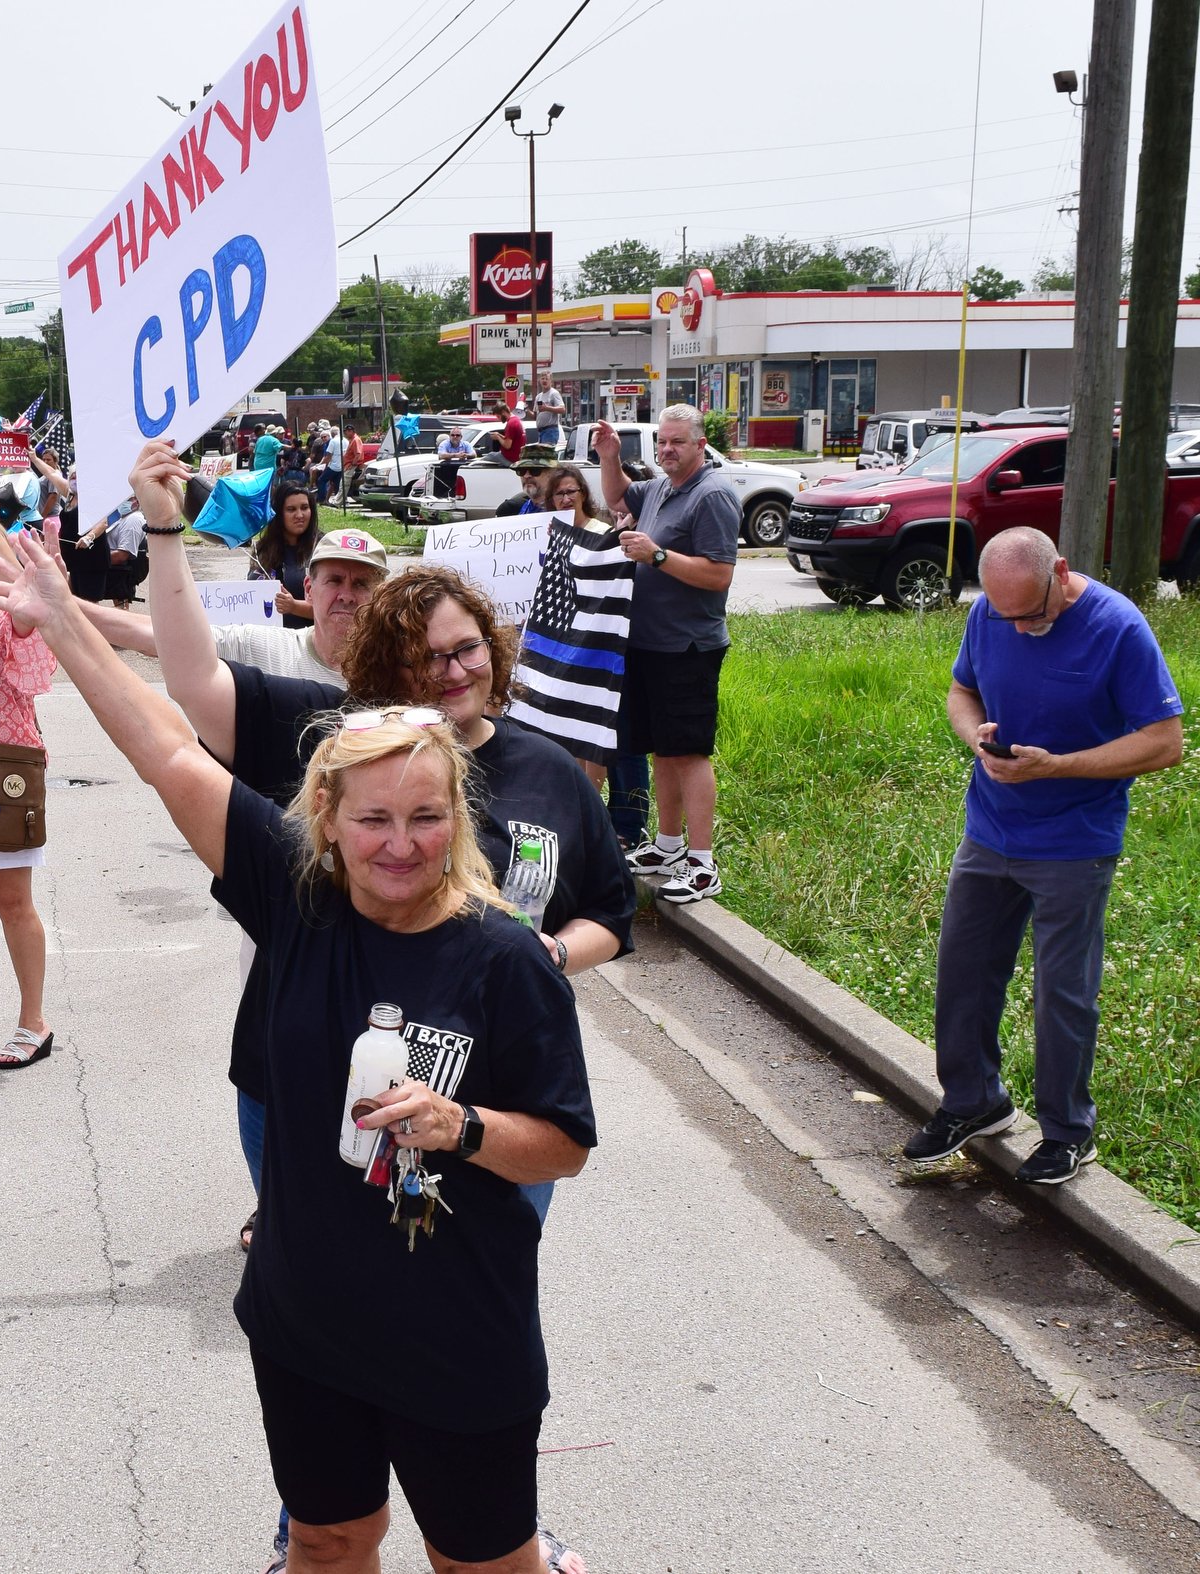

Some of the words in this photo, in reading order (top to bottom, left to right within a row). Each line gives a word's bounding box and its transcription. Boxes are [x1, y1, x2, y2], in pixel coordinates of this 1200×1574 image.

[67, 105, 225, 314] THANK
[213, 5, 308, 174] YOU
[133, 234, 267, 439] CPD
[481, 328, 509, 338] DRIVE
[504, 339, 527, 348] ONLY
[672, 341, 701, 355] BURGERS
[767, 380, 784, 390] BBQ
[433, 528, 460, 550] WE
[492, 558, 533, 578] LAW
[511, 822, 516, 832] I
[520, 824, 556, 843] BACK
[406, 1025, 414, 1039] I
[417, 1028, 470, 1055] BACK
